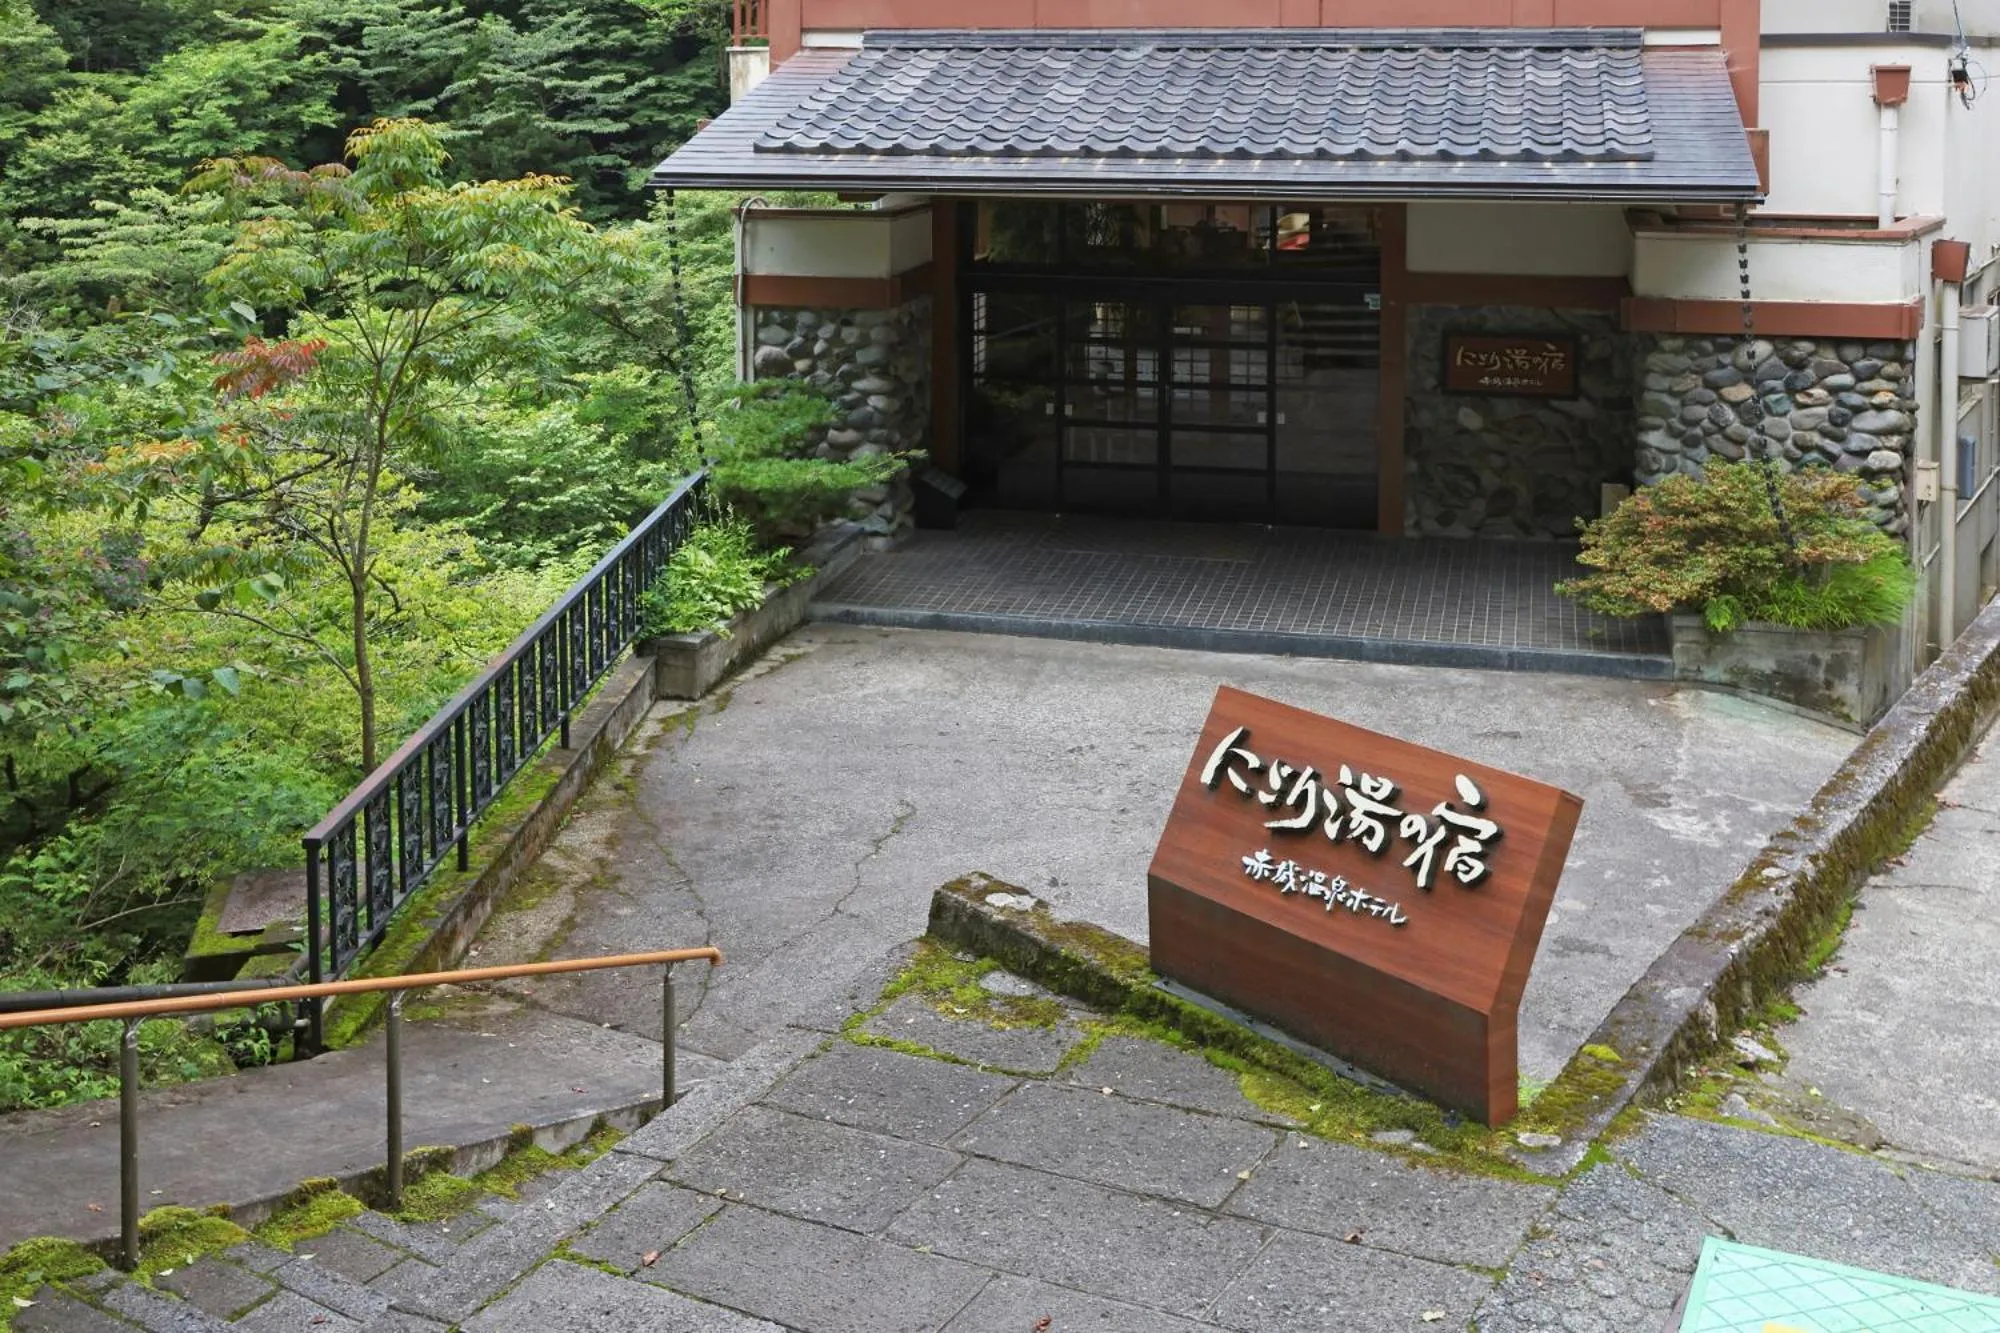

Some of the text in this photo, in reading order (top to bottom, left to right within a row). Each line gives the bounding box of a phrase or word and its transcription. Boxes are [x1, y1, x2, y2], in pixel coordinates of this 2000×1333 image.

[1200, 726, 1498, 888] にごり湯の宿
[1241, 848, 1408, 924] 赤城温泉ホテル
